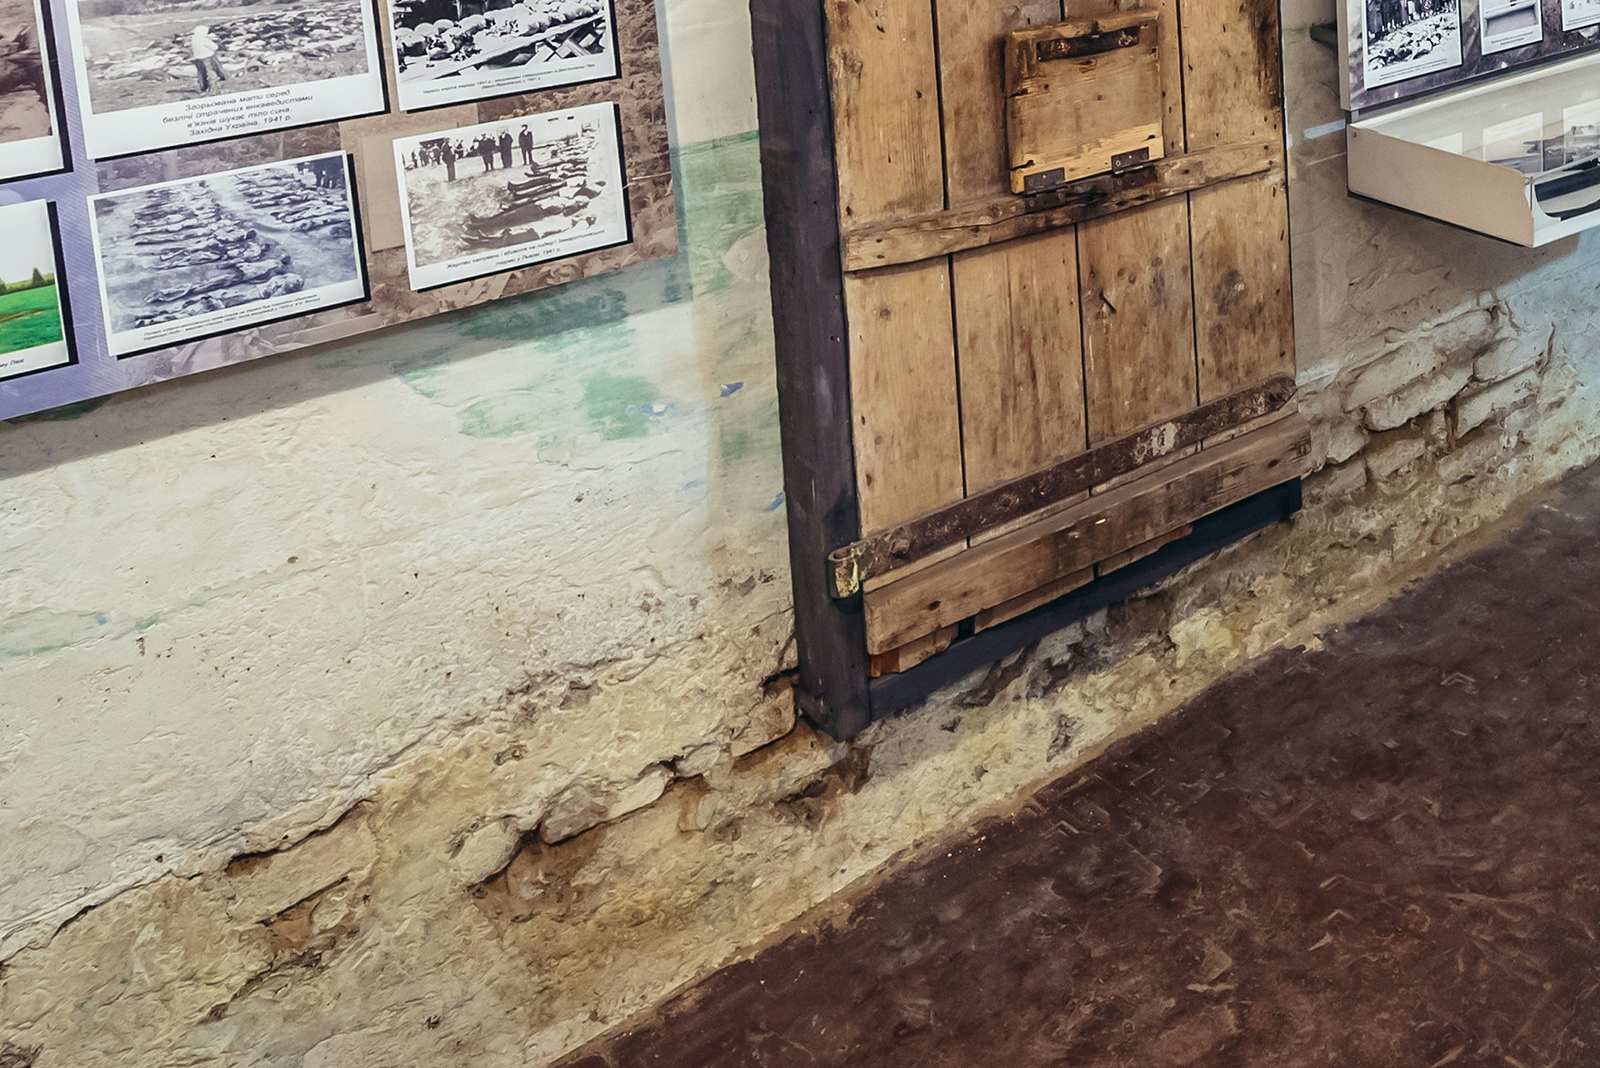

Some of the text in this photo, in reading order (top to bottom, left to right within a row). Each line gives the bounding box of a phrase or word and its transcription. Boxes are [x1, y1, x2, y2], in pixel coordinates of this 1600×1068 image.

[239, 93, 263, 102] мати
[266, 89, 291, 100] серед
[195, 106, 244, 119] страчених
[248, 110, 268, 118] тіло
[264, 115, 283, 124] 1941
